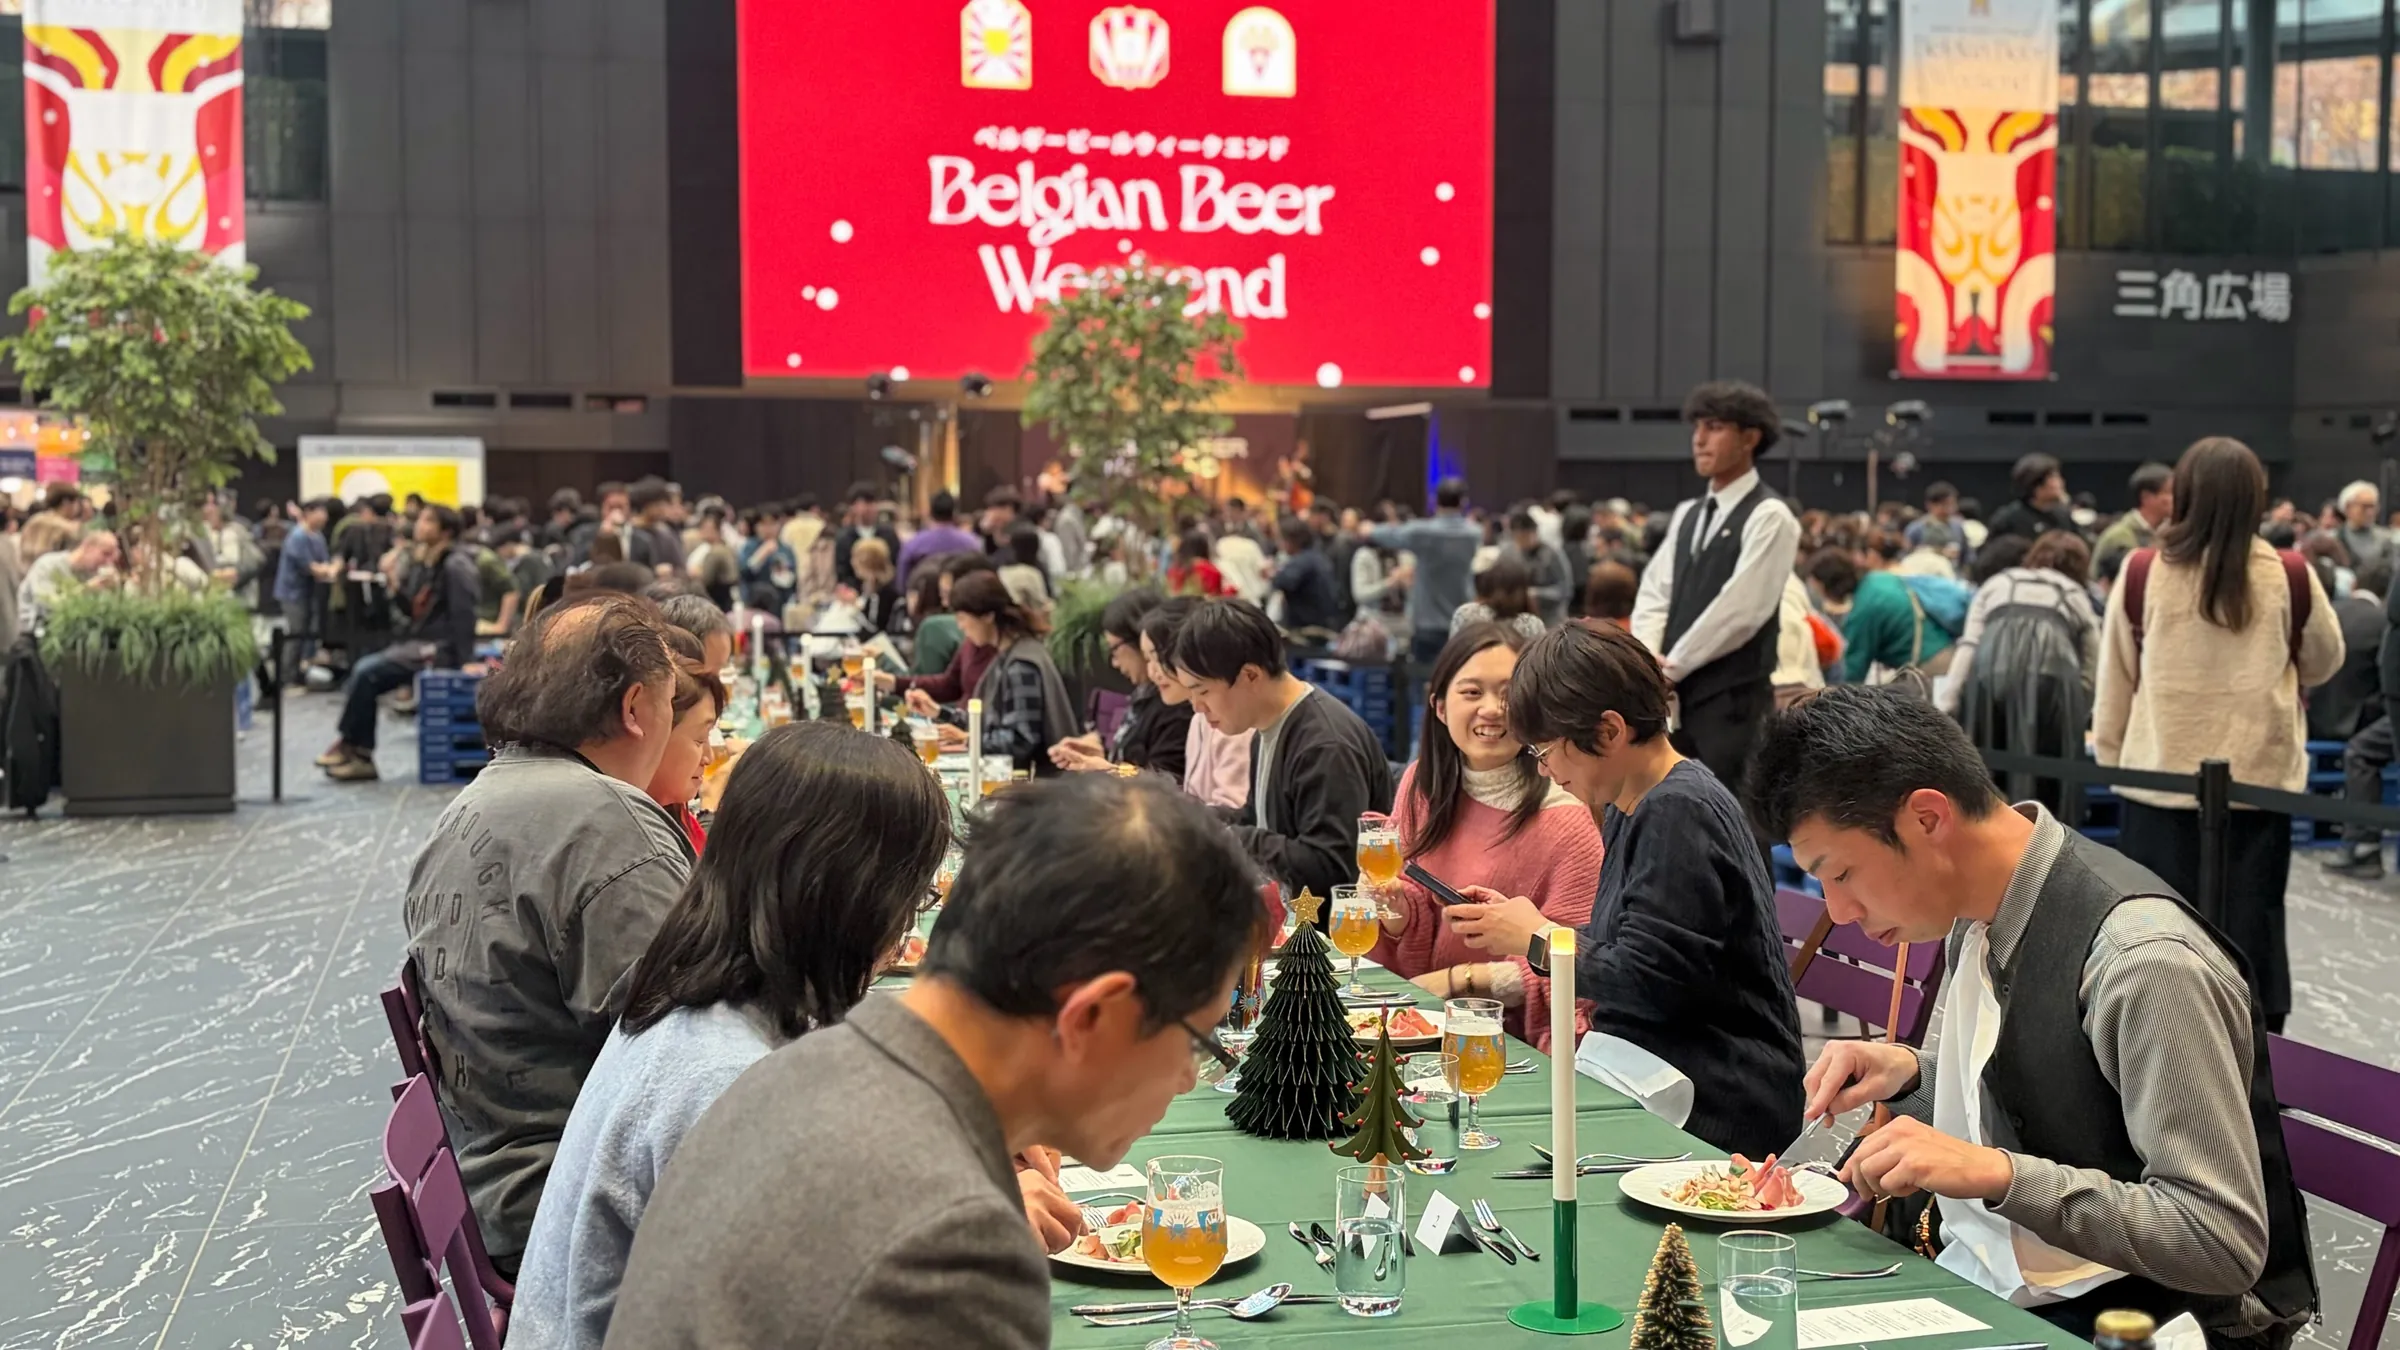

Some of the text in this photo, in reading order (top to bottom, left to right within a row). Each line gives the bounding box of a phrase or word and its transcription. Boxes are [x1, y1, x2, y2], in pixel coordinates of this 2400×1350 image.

[974, 125, 1290, 161] ベルギービールウィークエンド
[928, 155, 1335, 248] Belgian Beer
[978, 243, 1288, 319] Weend
[2113, 268, 2292, 322] 三角広場
